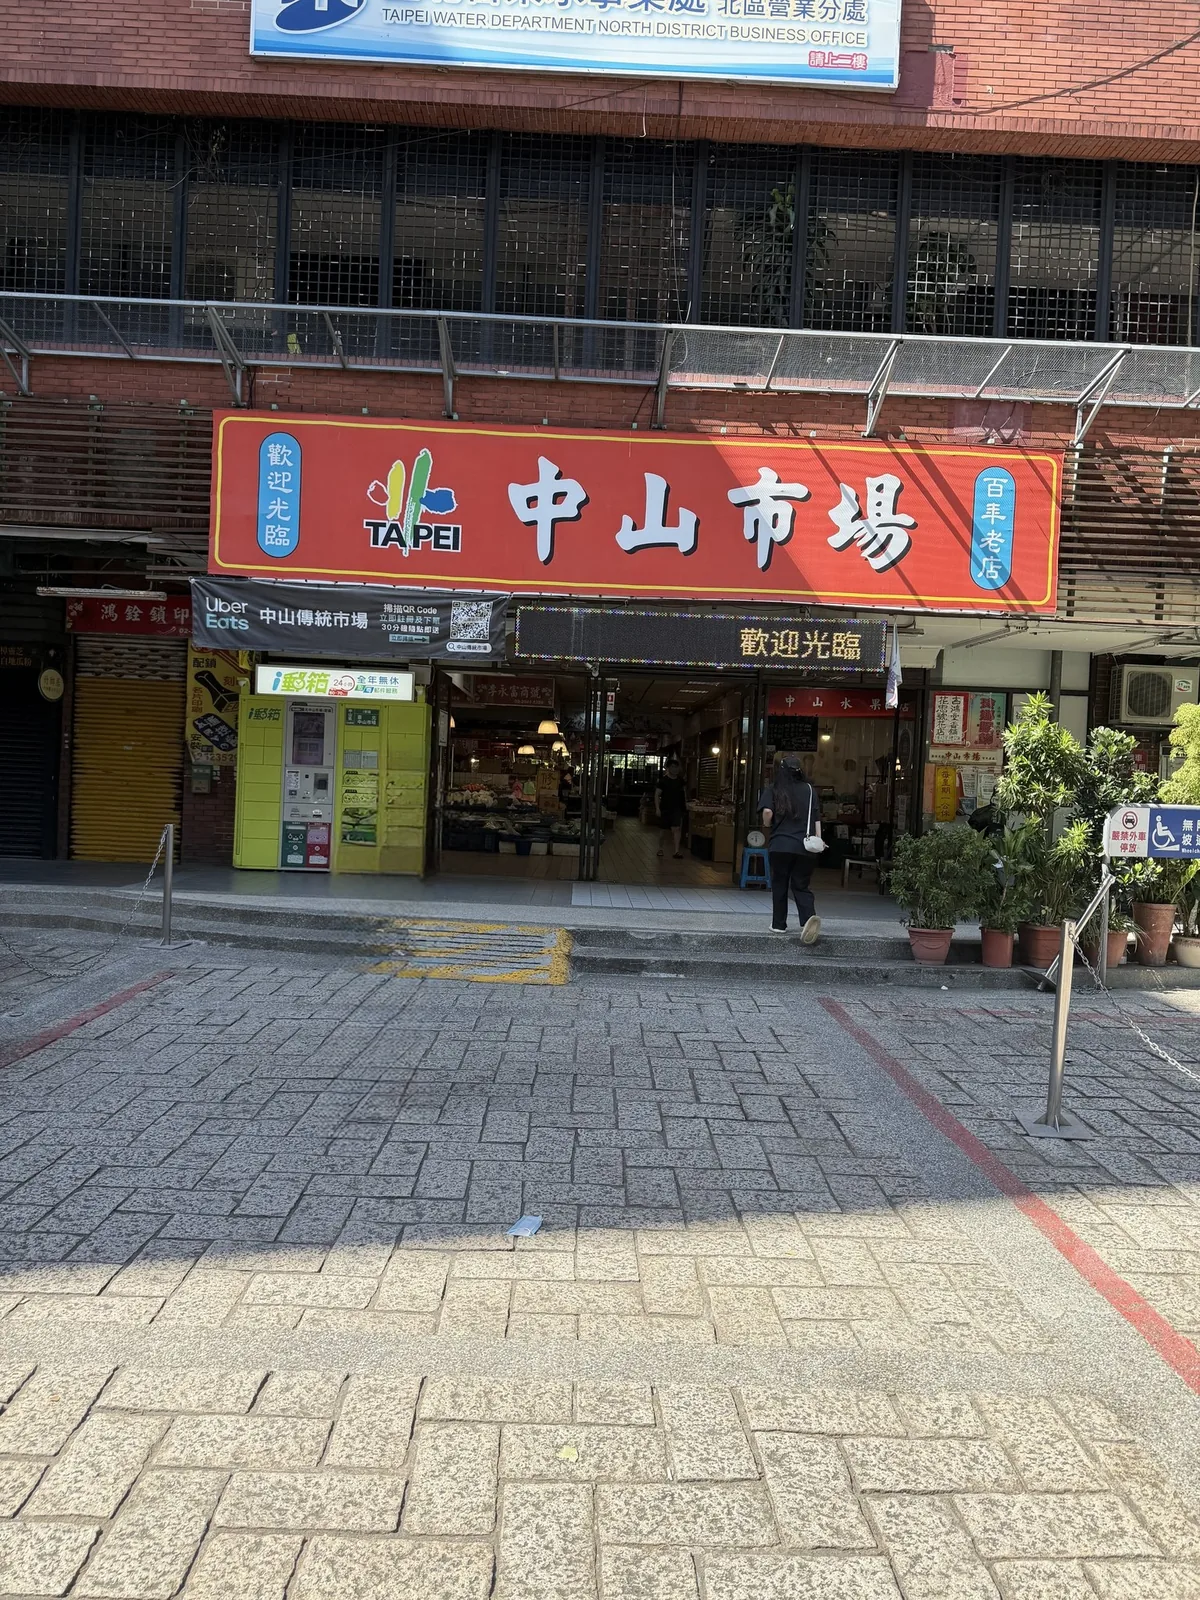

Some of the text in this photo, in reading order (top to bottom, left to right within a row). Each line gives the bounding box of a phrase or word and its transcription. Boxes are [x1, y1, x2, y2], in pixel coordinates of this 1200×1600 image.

[718, 0, 865, 22] 北區營業分處
[382, 8, 865, 45] TAIPEI WATER DEPARTMENT NORTH DISTRICT BUSINESS OFFICE
[810, 51, 867, 69] 請上二樓
[265, 443, 291, 548] 歡迎光臨
[508, 456, 917, 571] 中山市場
[364, 519, 461, 554] TAIPEI
[979, 476, 1008, 580] 百年老店
[205, 596, 249, 614] Uber
[383, 603, 437, 615] 掃描QR Code
[205, 614, 250, 631] Eats
[259, 606, 369, 630] 中山傳統市場
[740, 627, 862, 660] 歡迎光臨
[193, 657, 216, 668] 配鎖
[271, 671, 331, 694] i郵箱
[357, 675, 400, 685] 全年無休
[248, 707, 281, 721] i郵箱
[1111, 830, 1147, 841] 嚴禁外車
[1119, 842, 1137, 853] 停放
